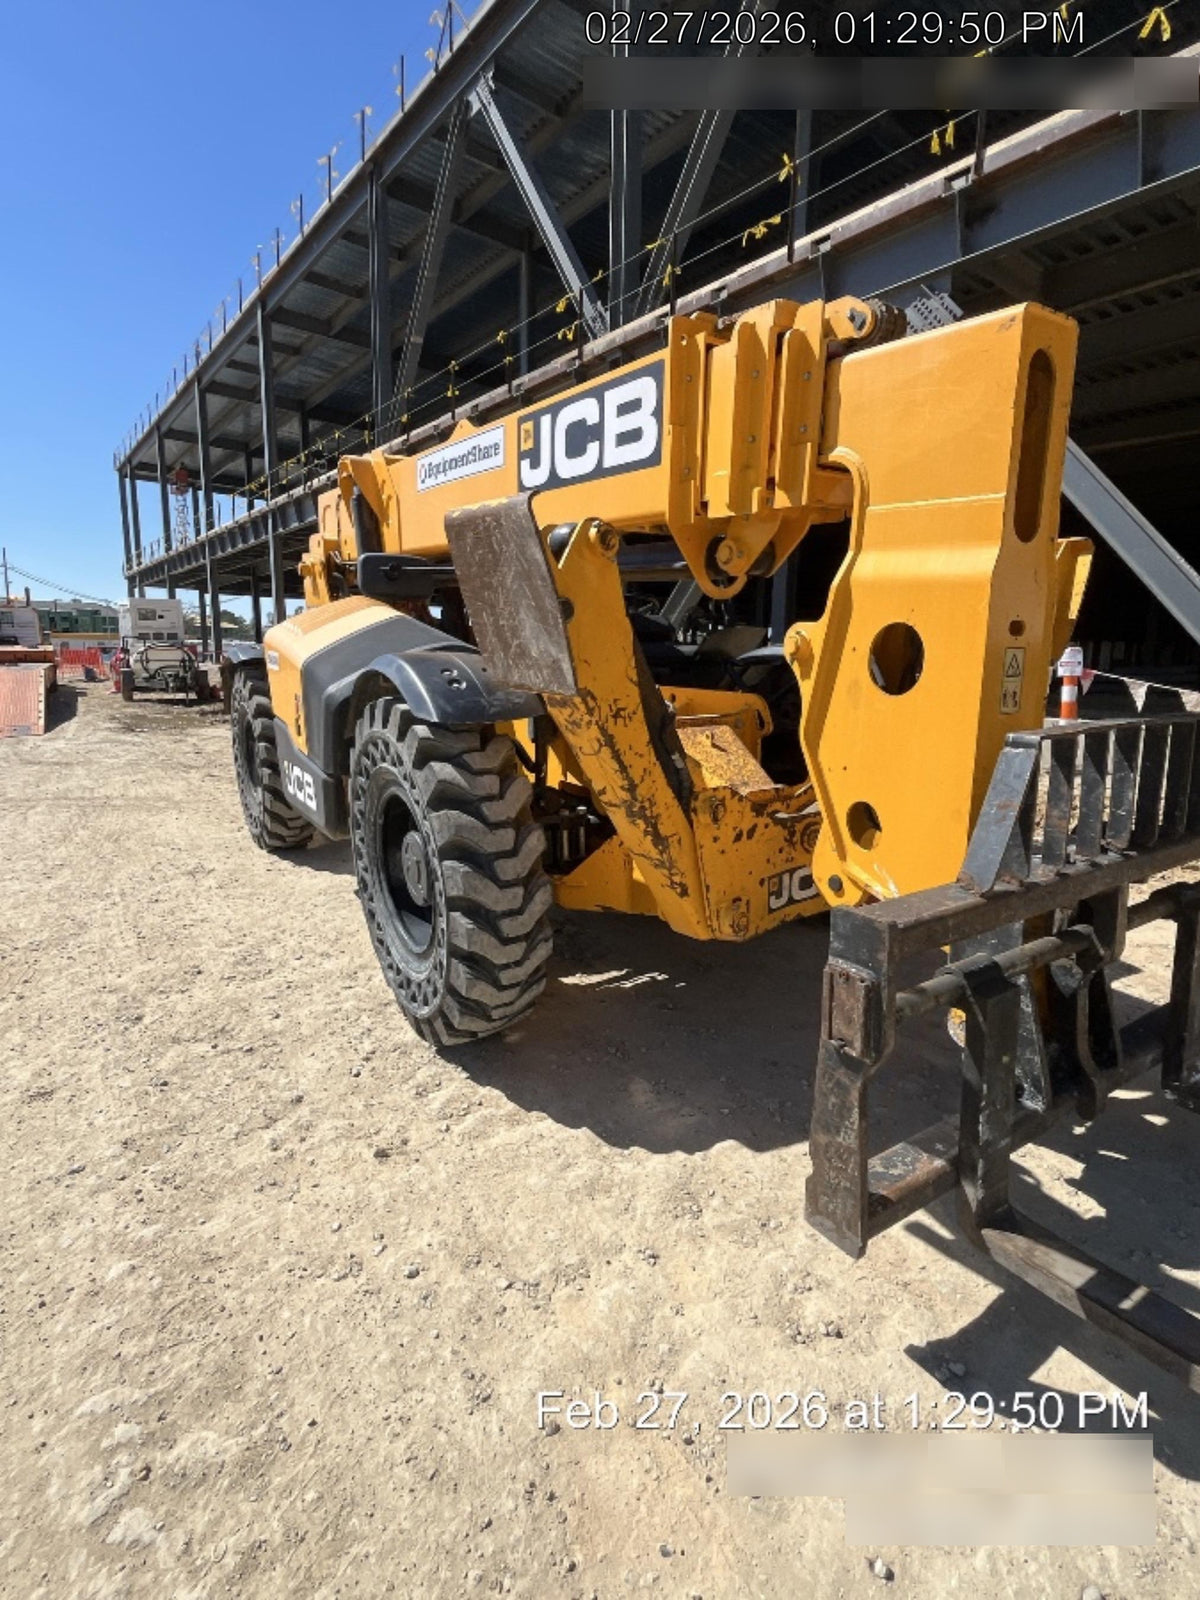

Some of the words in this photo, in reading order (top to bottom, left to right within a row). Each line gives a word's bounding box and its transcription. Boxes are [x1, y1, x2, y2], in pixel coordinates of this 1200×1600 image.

[520, 376, 658, 487] JCB
[427, 441, 501, 480] EquipmentShare
[286, 763, 317, 811] JCB
[769, 866, 818, 910] JC
